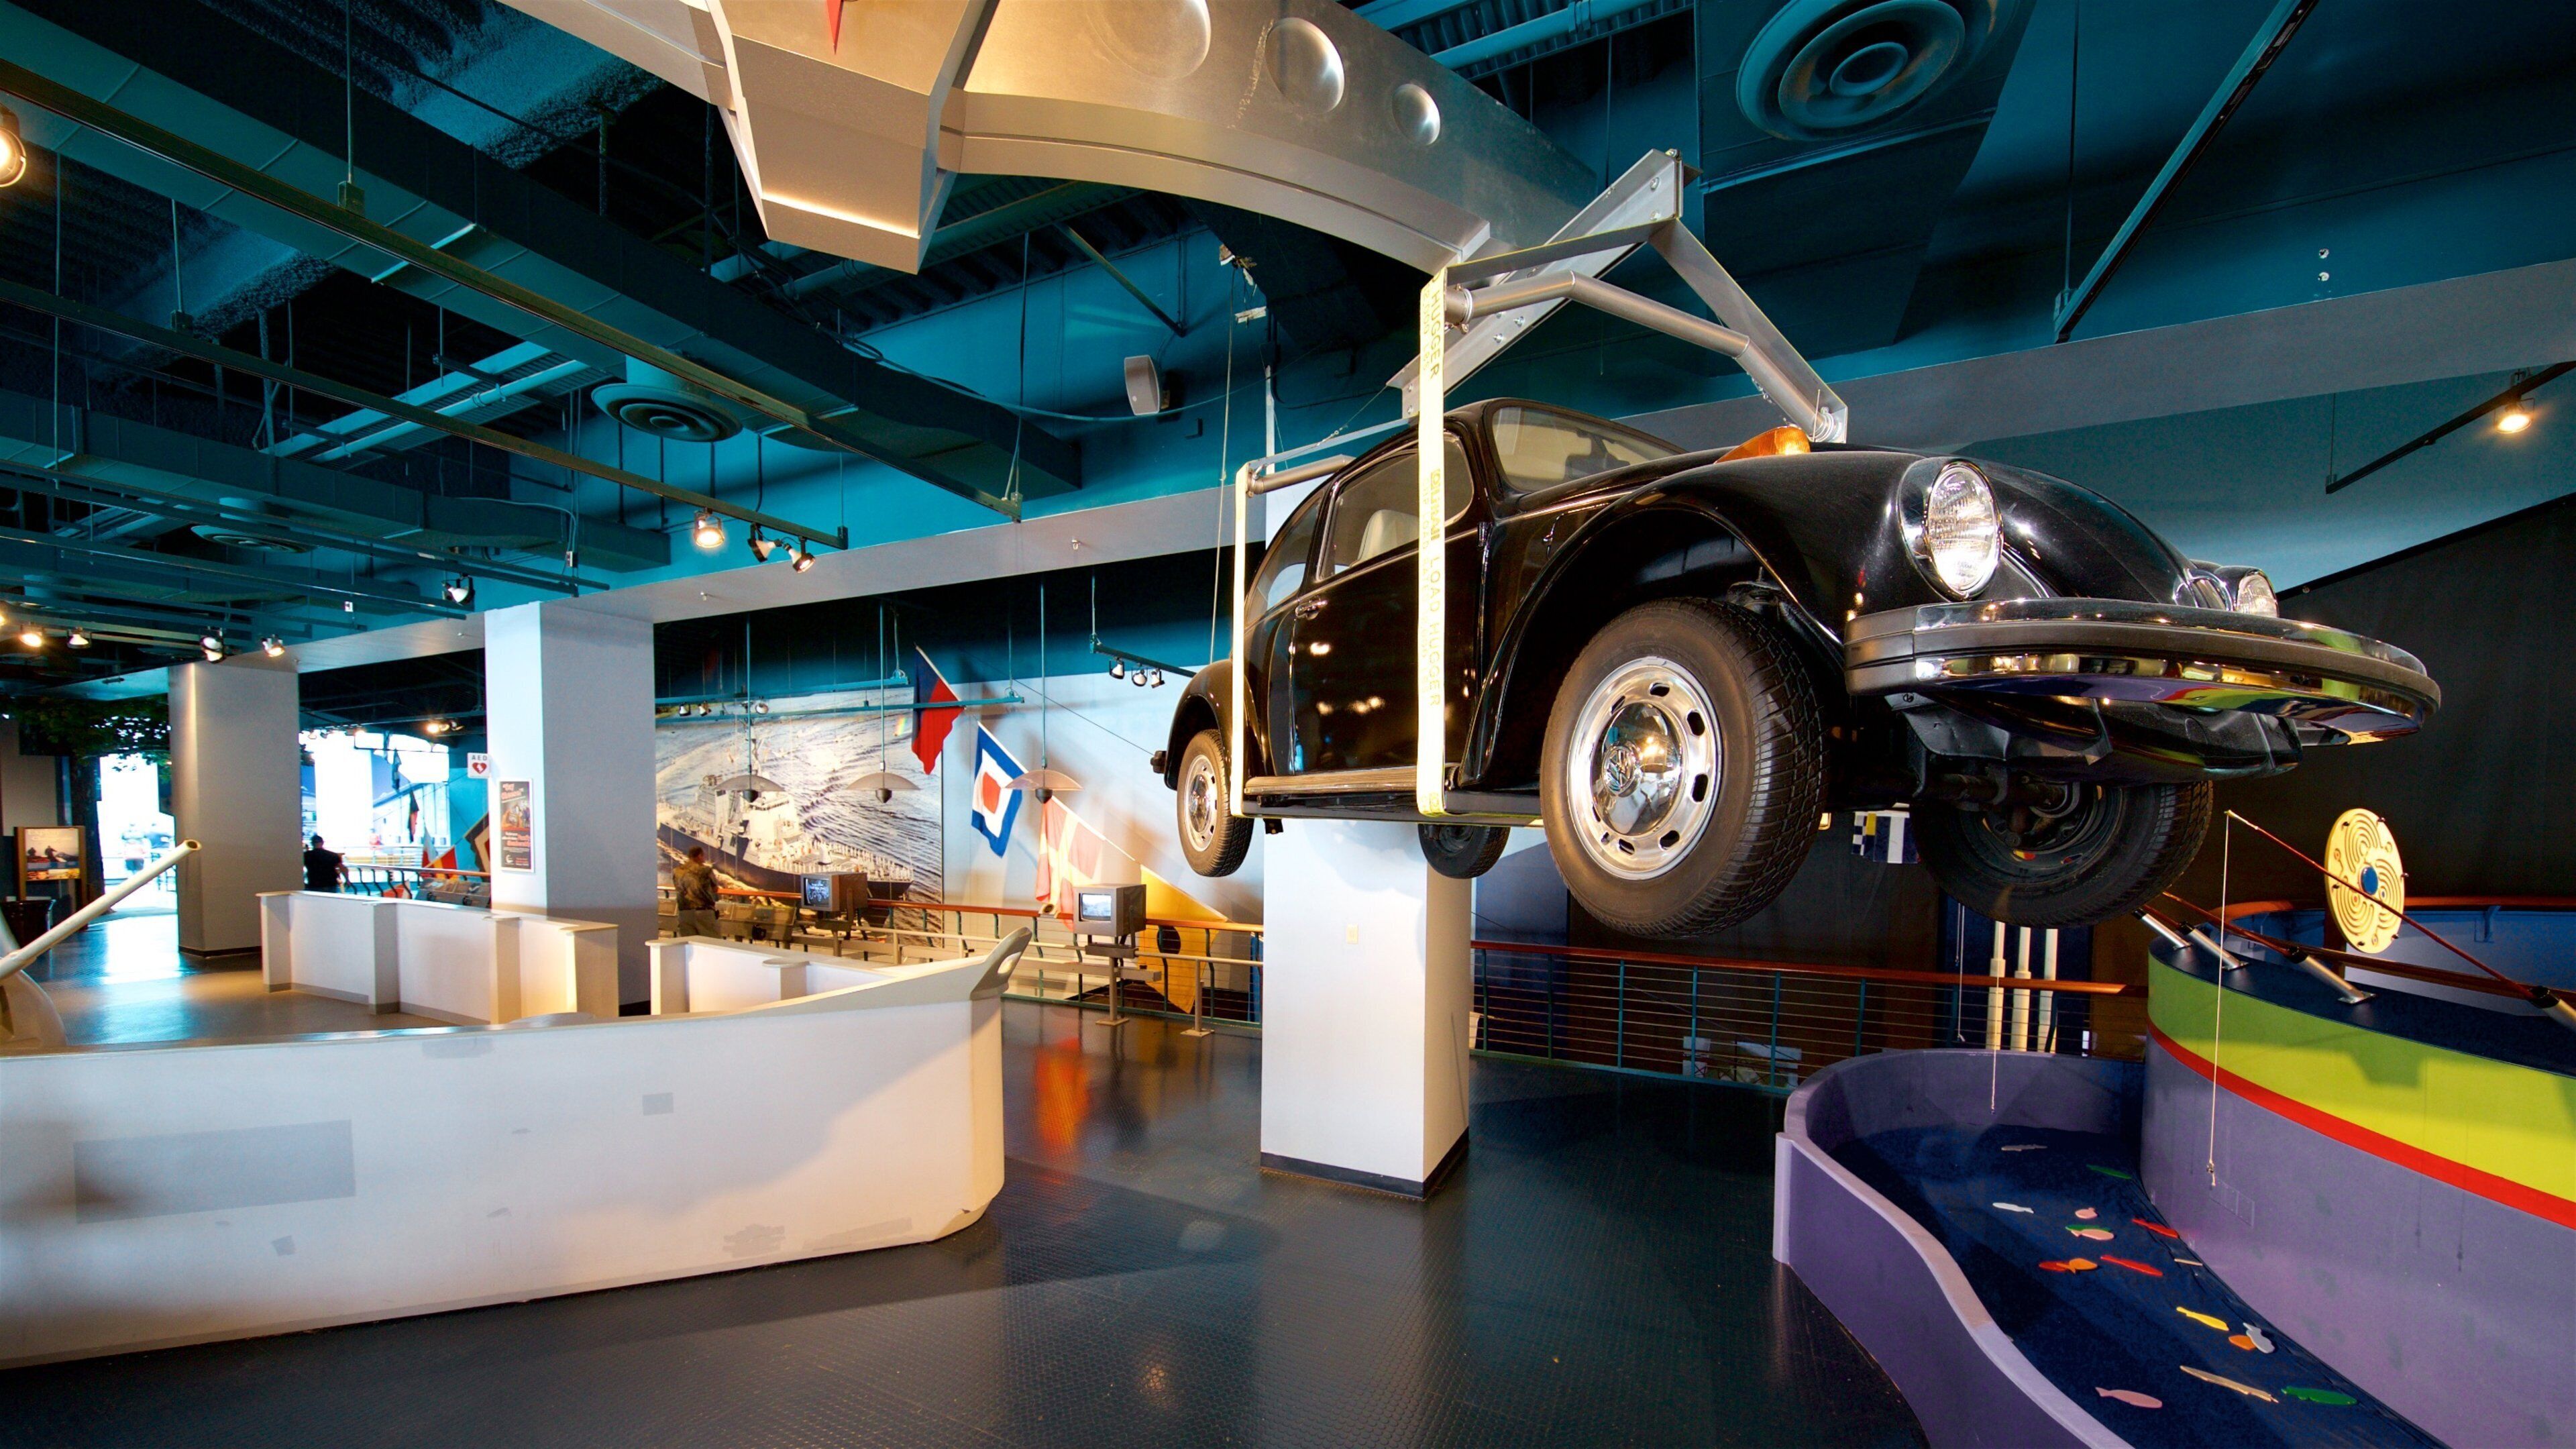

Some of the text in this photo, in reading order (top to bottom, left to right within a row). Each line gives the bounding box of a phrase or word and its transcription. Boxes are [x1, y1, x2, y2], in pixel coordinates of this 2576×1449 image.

[1430, 290, 1442, 380] HUGGER
[1430, 556, 1441, 612] LOAD
[1429, 623, 1441, 706] HUGGER
